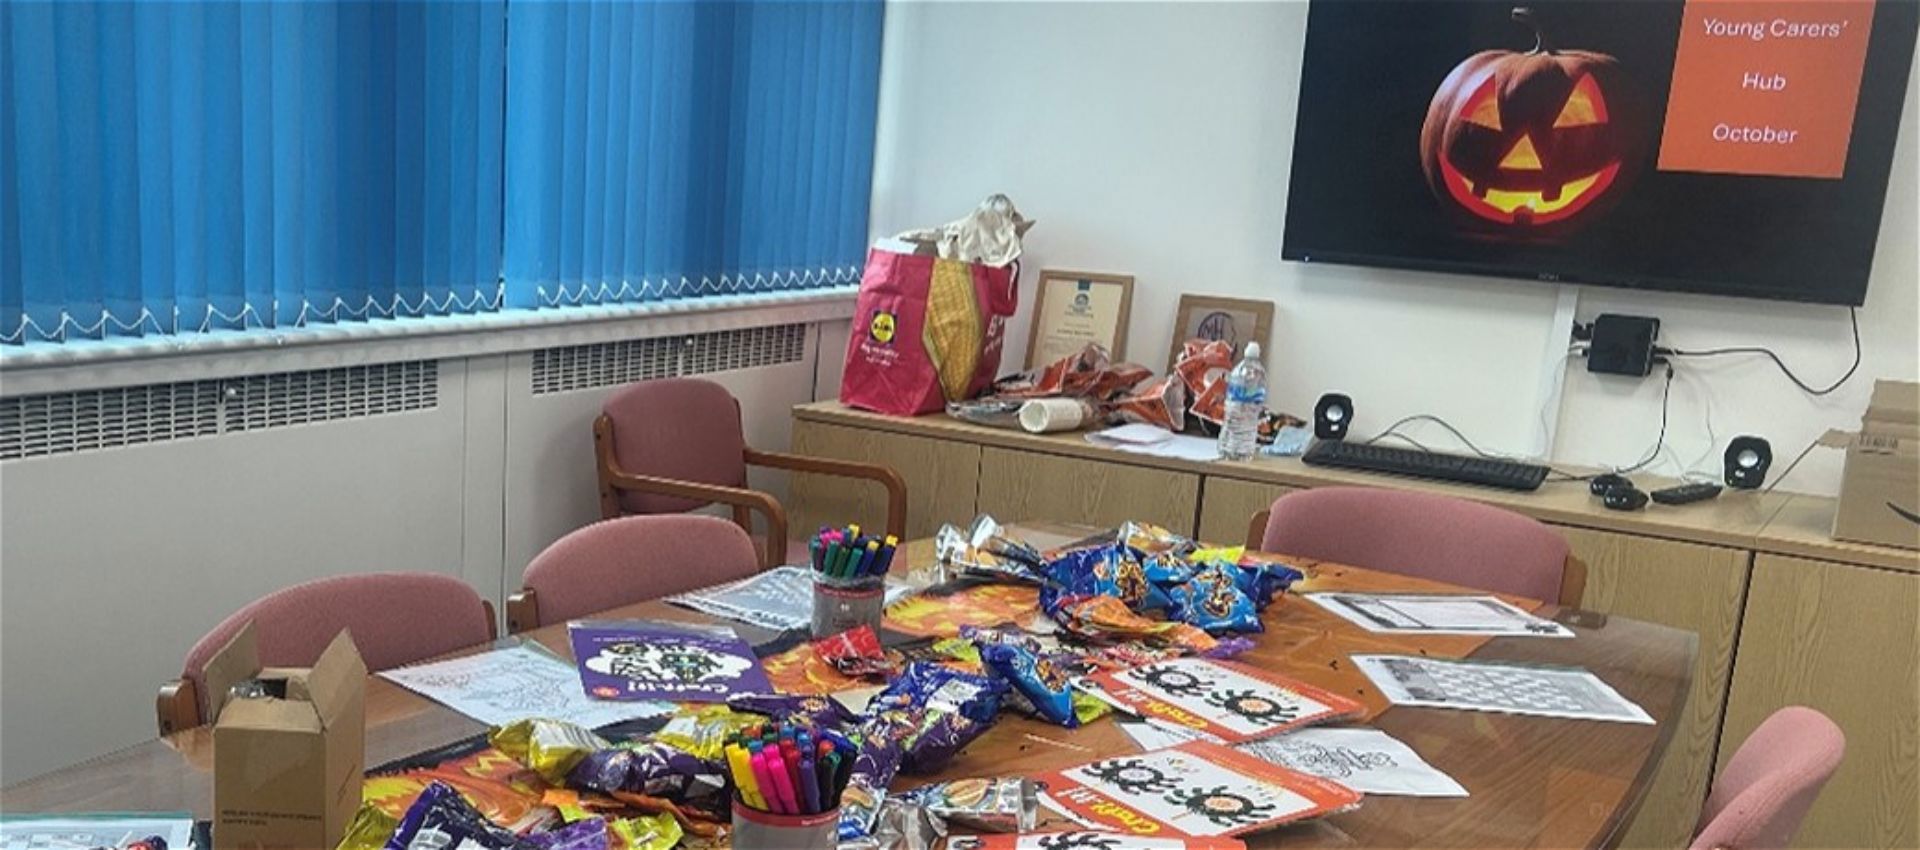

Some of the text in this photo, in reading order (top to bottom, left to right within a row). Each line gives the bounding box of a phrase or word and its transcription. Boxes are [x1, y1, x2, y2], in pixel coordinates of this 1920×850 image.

[1703, 19, 1848, 41] Young Carers'
[1742, 72, 1786, 91] Hub
[1712, 123, 1798, 144] October
